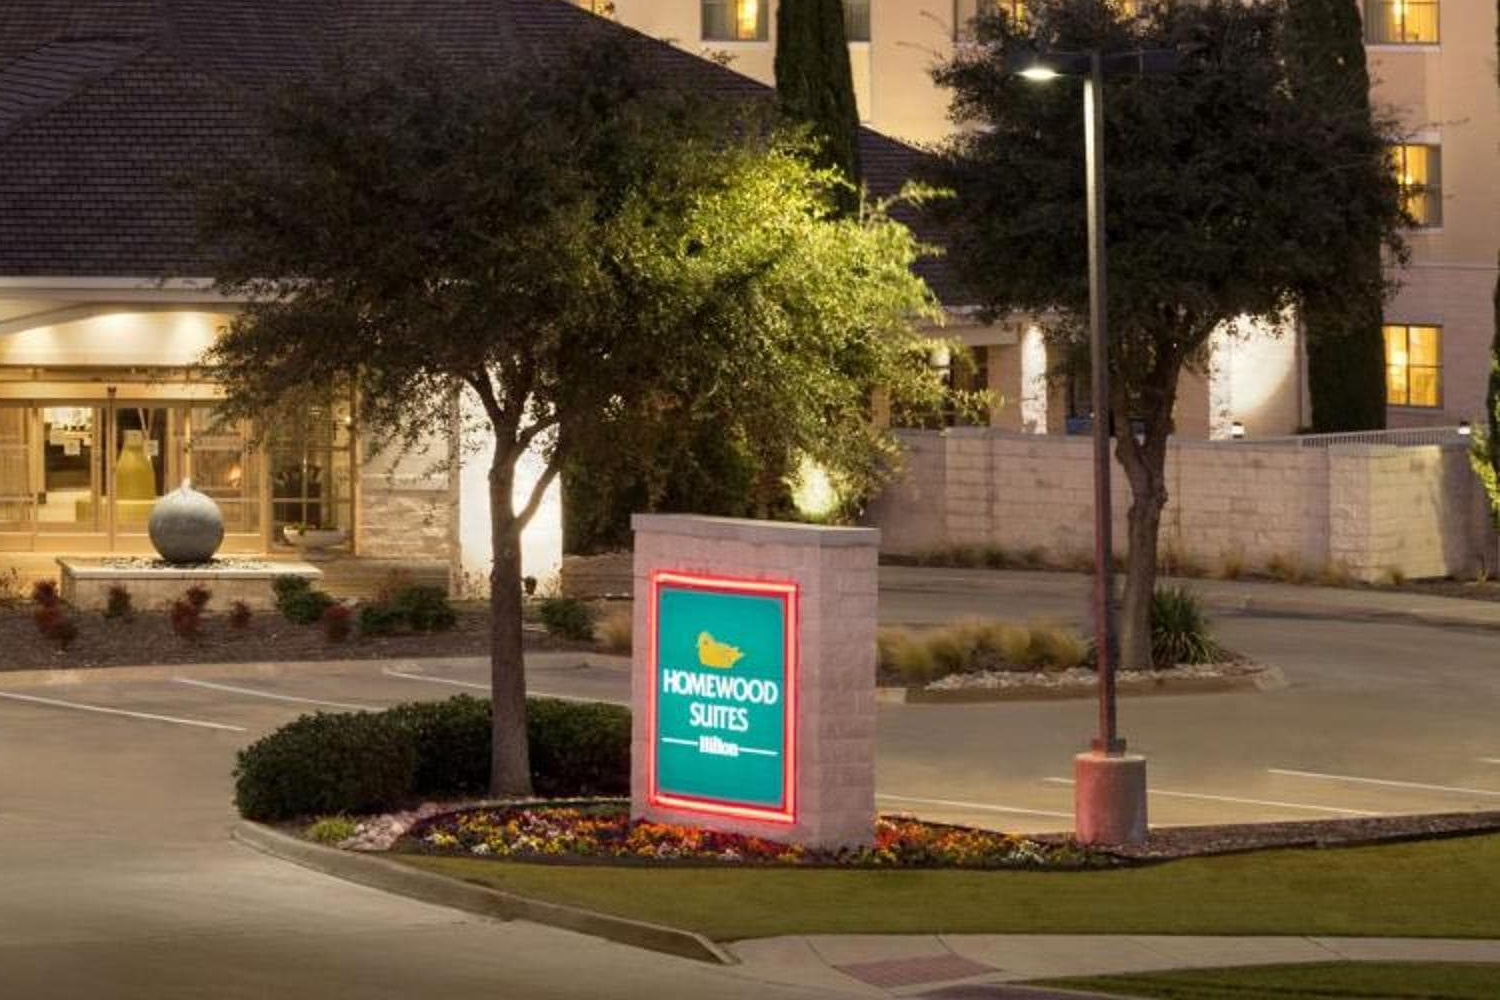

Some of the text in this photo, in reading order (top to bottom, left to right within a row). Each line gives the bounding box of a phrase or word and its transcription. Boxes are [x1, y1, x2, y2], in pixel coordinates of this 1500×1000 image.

[663, 669, 778, 705] HOMEWOOD
[689, 702, 748, 731] SUITES
[699, 735, 739, 757] Hilton
